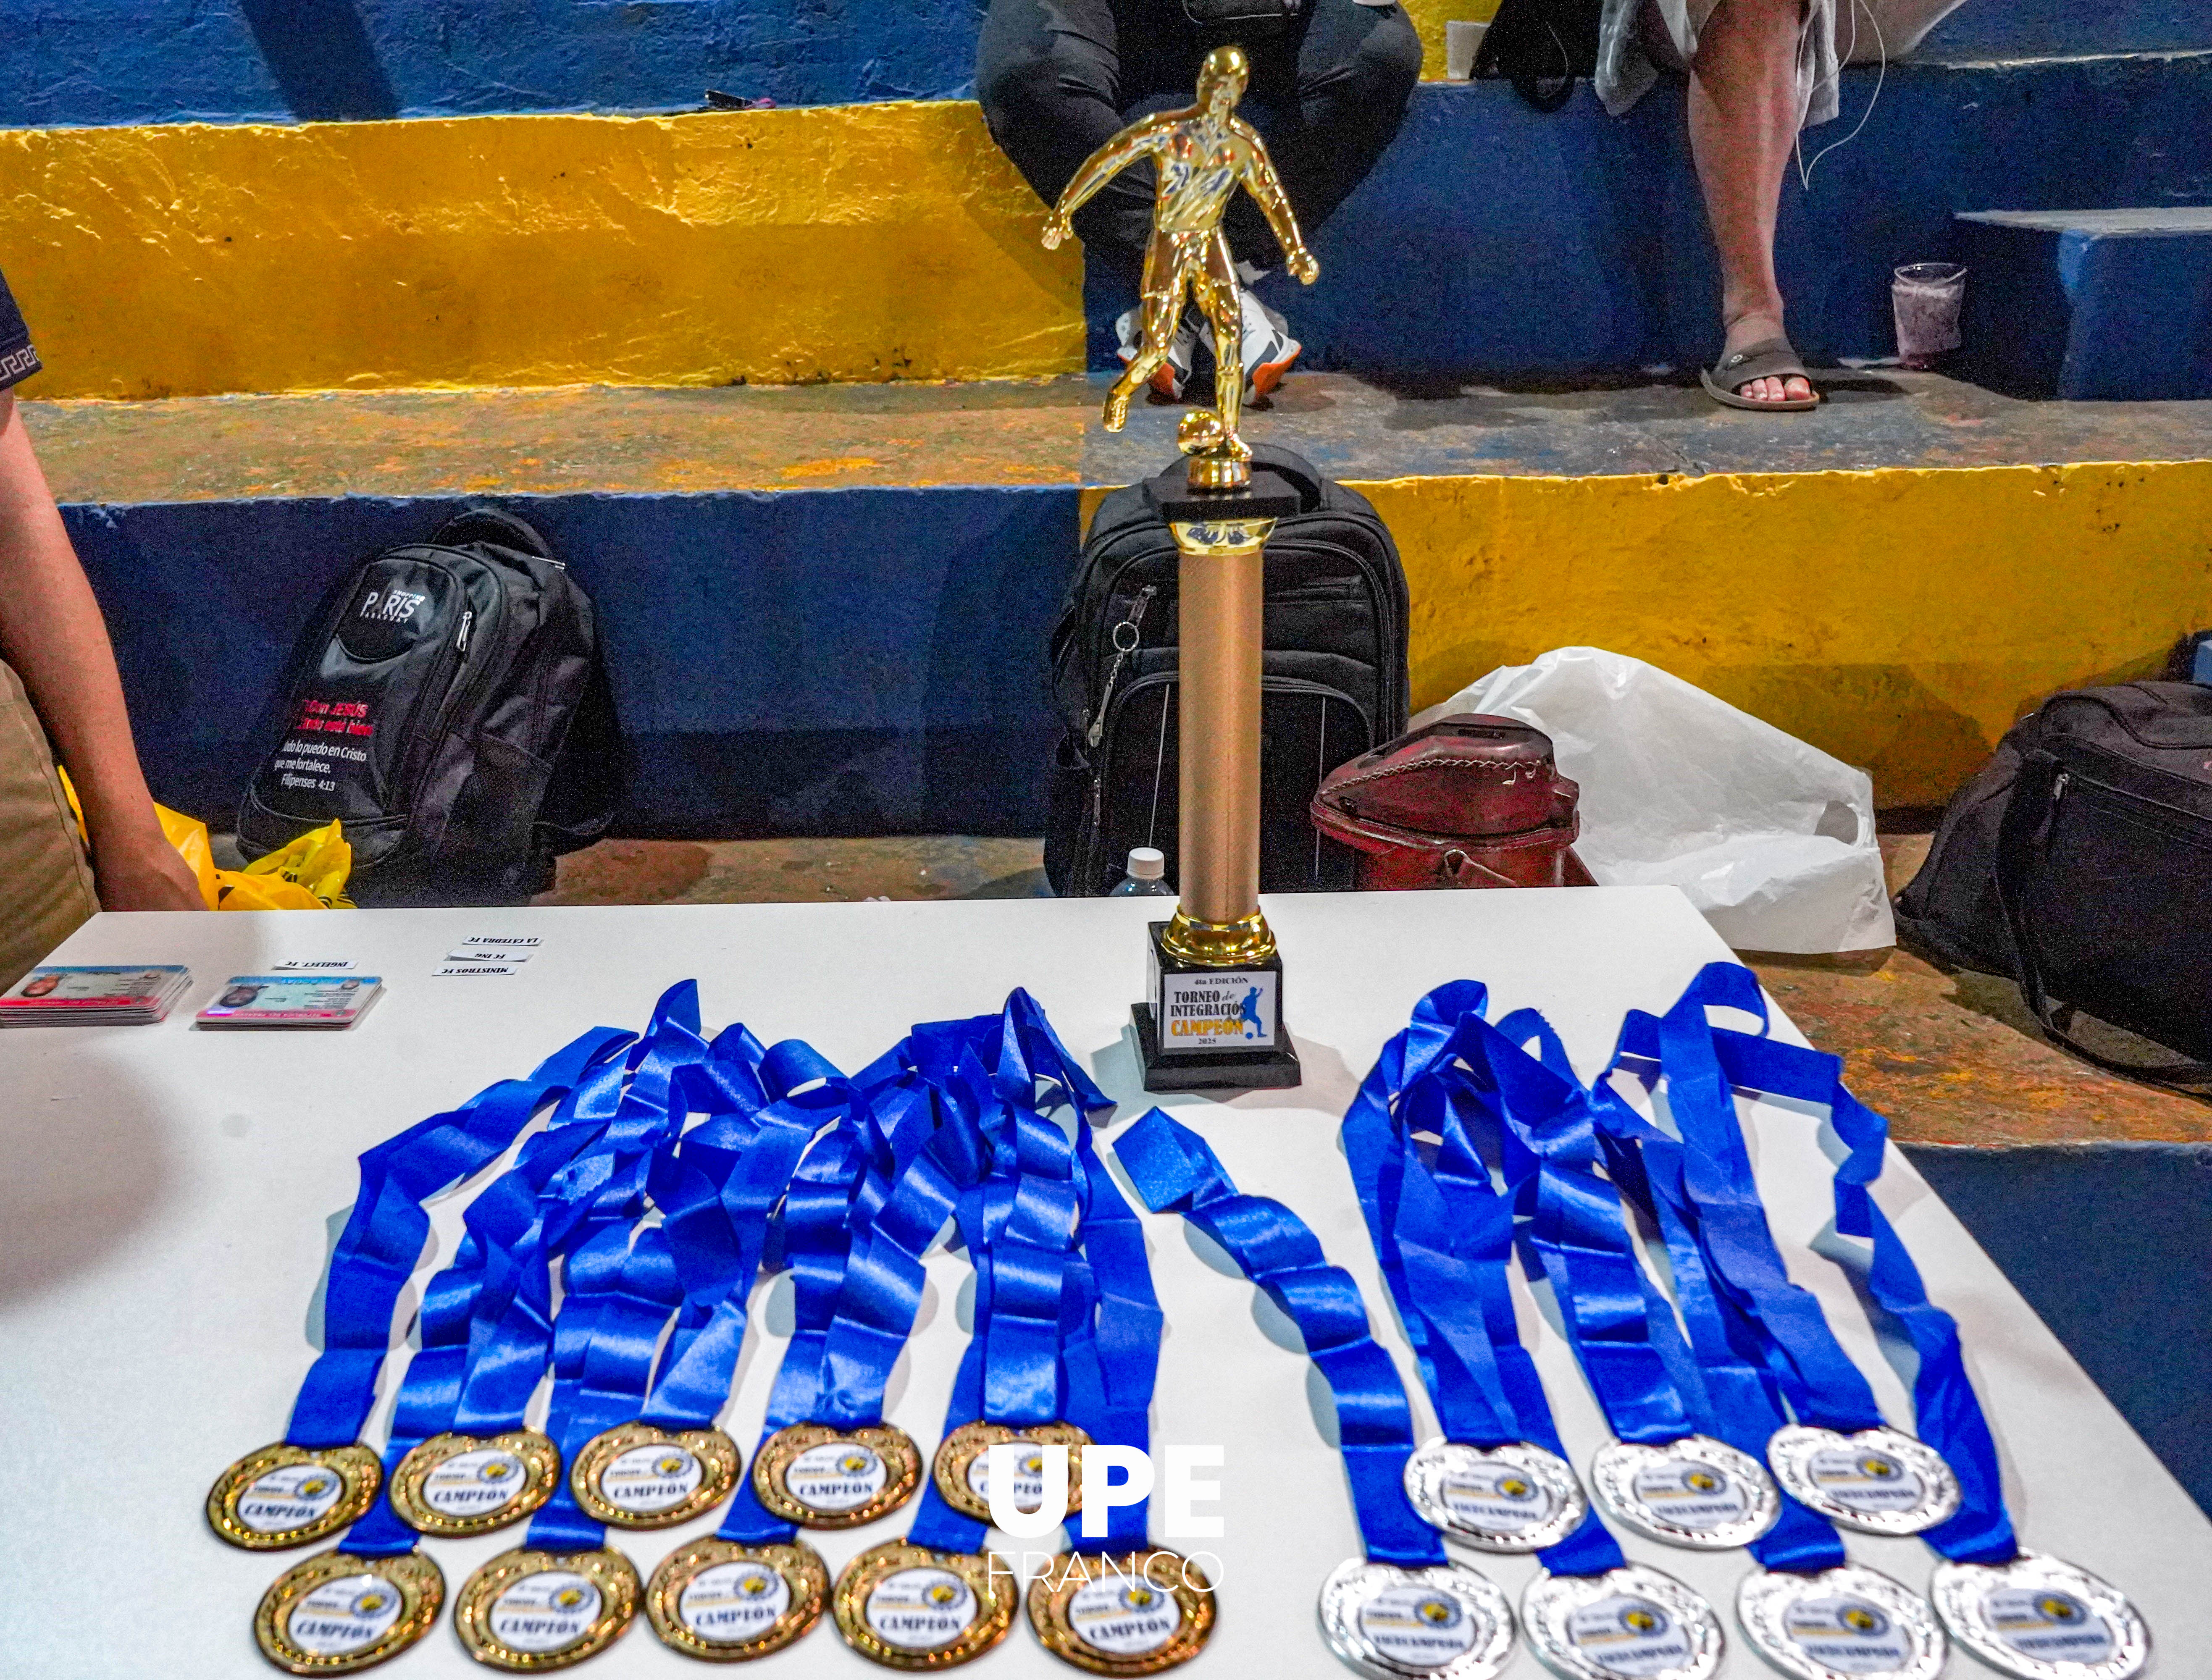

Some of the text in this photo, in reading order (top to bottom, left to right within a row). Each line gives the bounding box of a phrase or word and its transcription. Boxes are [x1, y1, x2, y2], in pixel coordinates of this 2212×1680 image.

[360, 592, 420, 618] PRIS
[301, 742, 328, 756] puedo
[328, 747, 341, 757] en
[341, 747, 367, 762] Cristo
[285, 759, 296, 769] me
[295, 758, 331, 774] fortalece.
[281, 773, 336, 791] Filipenses 4:13
[1208, 976, 1248, 984] EDICIÓN
[1174, 990, 1235, 1003] TORNEO de
